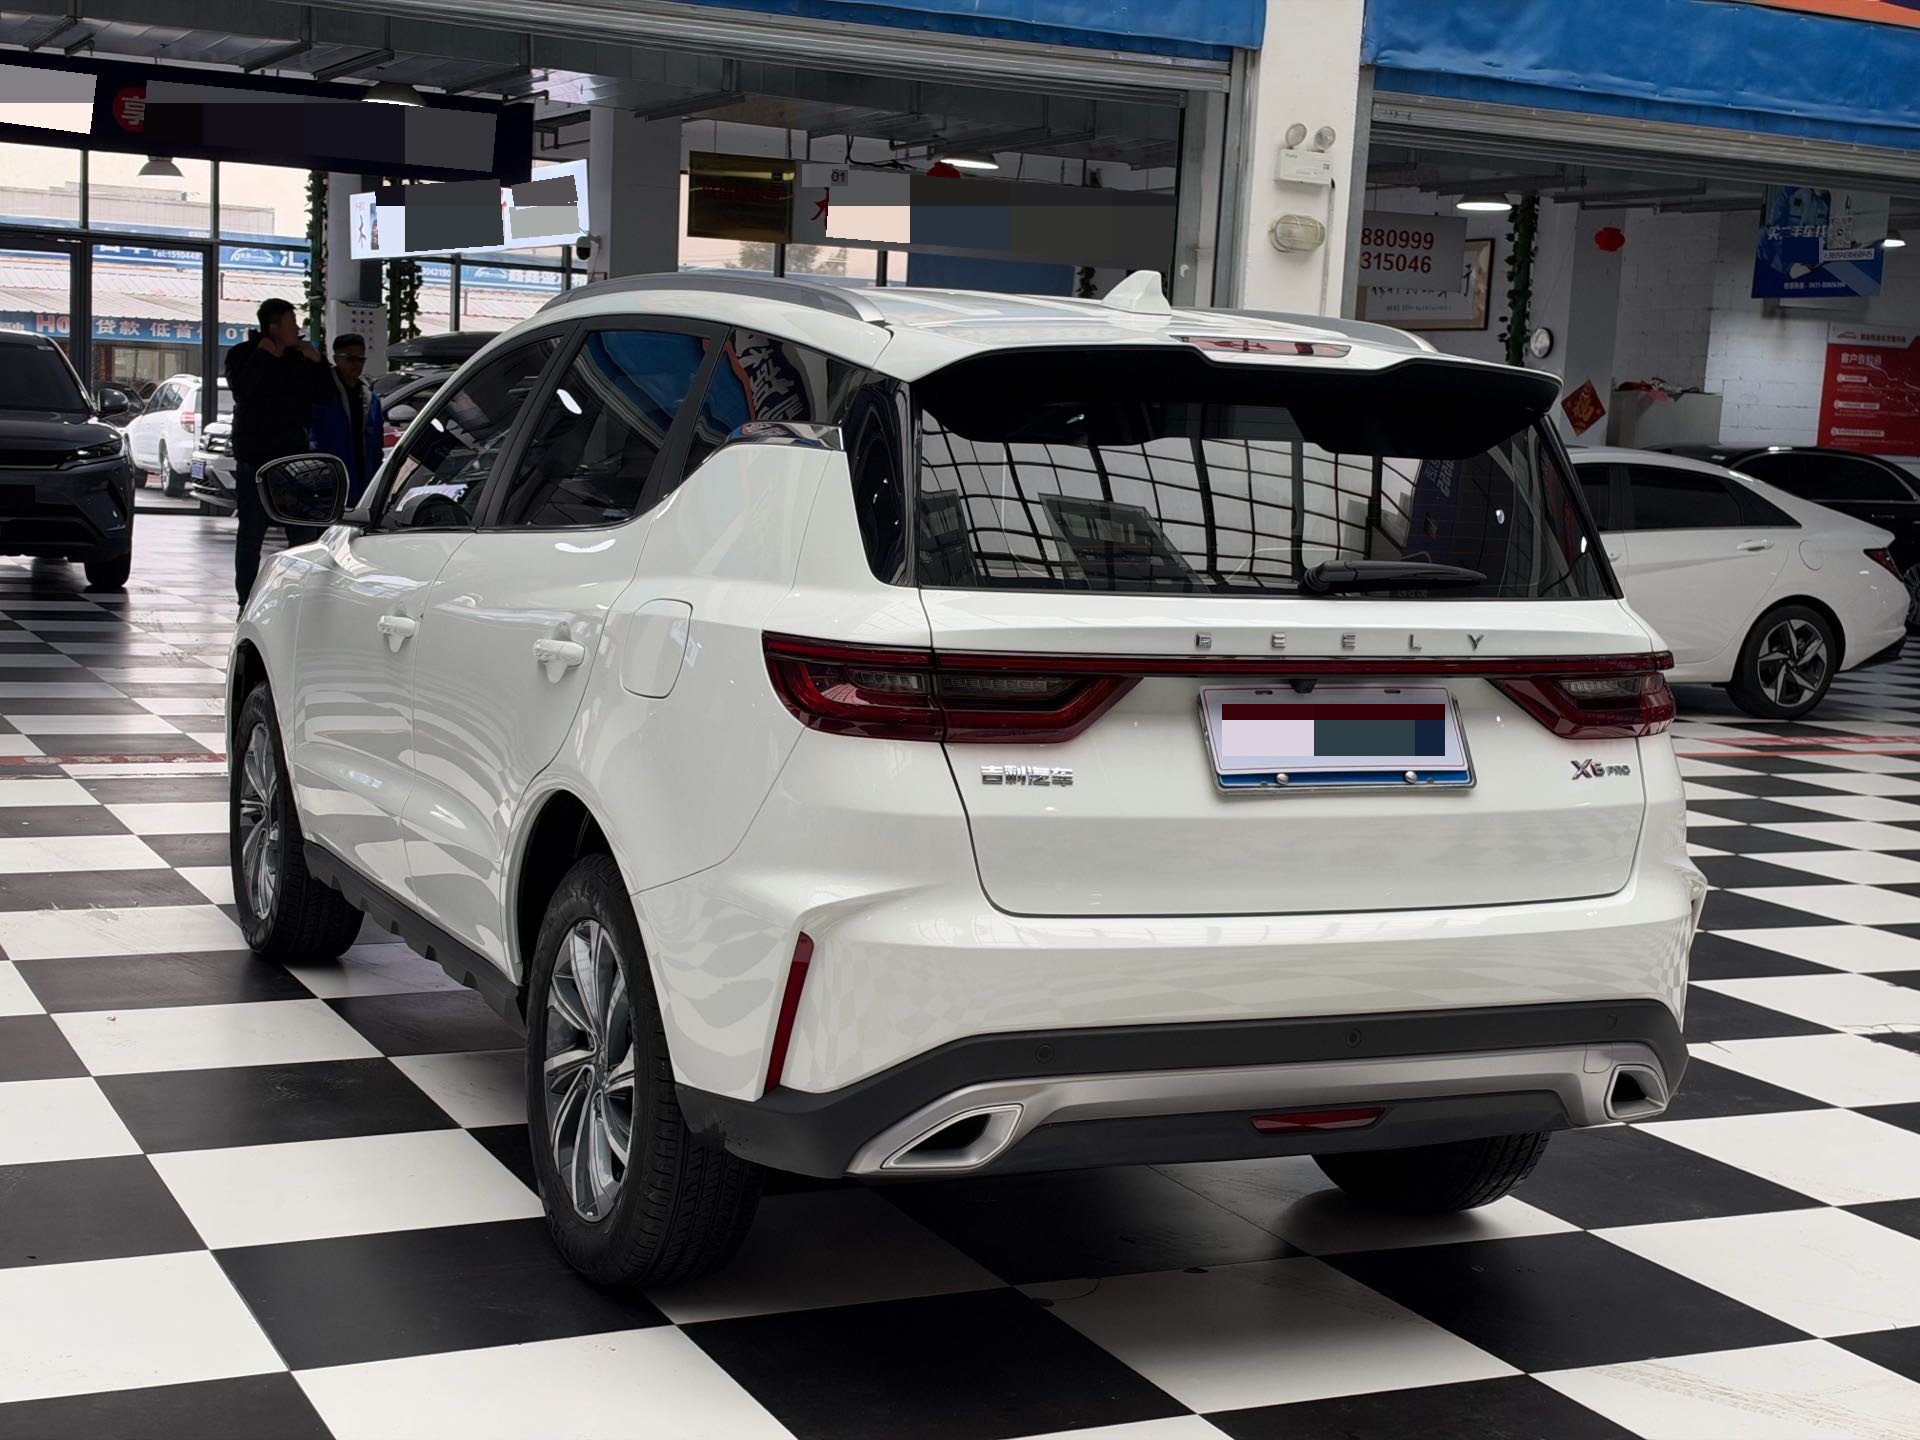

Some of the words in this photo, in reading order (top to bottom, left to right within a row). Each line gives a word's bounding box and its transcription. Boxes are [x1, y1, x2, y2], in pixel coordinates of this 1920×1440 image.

[1361, 227, 1434, 250] 880999
[1360, 251, 1432, 273] 315046
[96, 319, 141, 336] 贷款
[1195, 631, 1484, 651] GEELY
[980, 764, 1074, 787] 吉利汽车
[1570, 758, 1605, 780] X6
[1605, 764, 1631, 776] PRO
